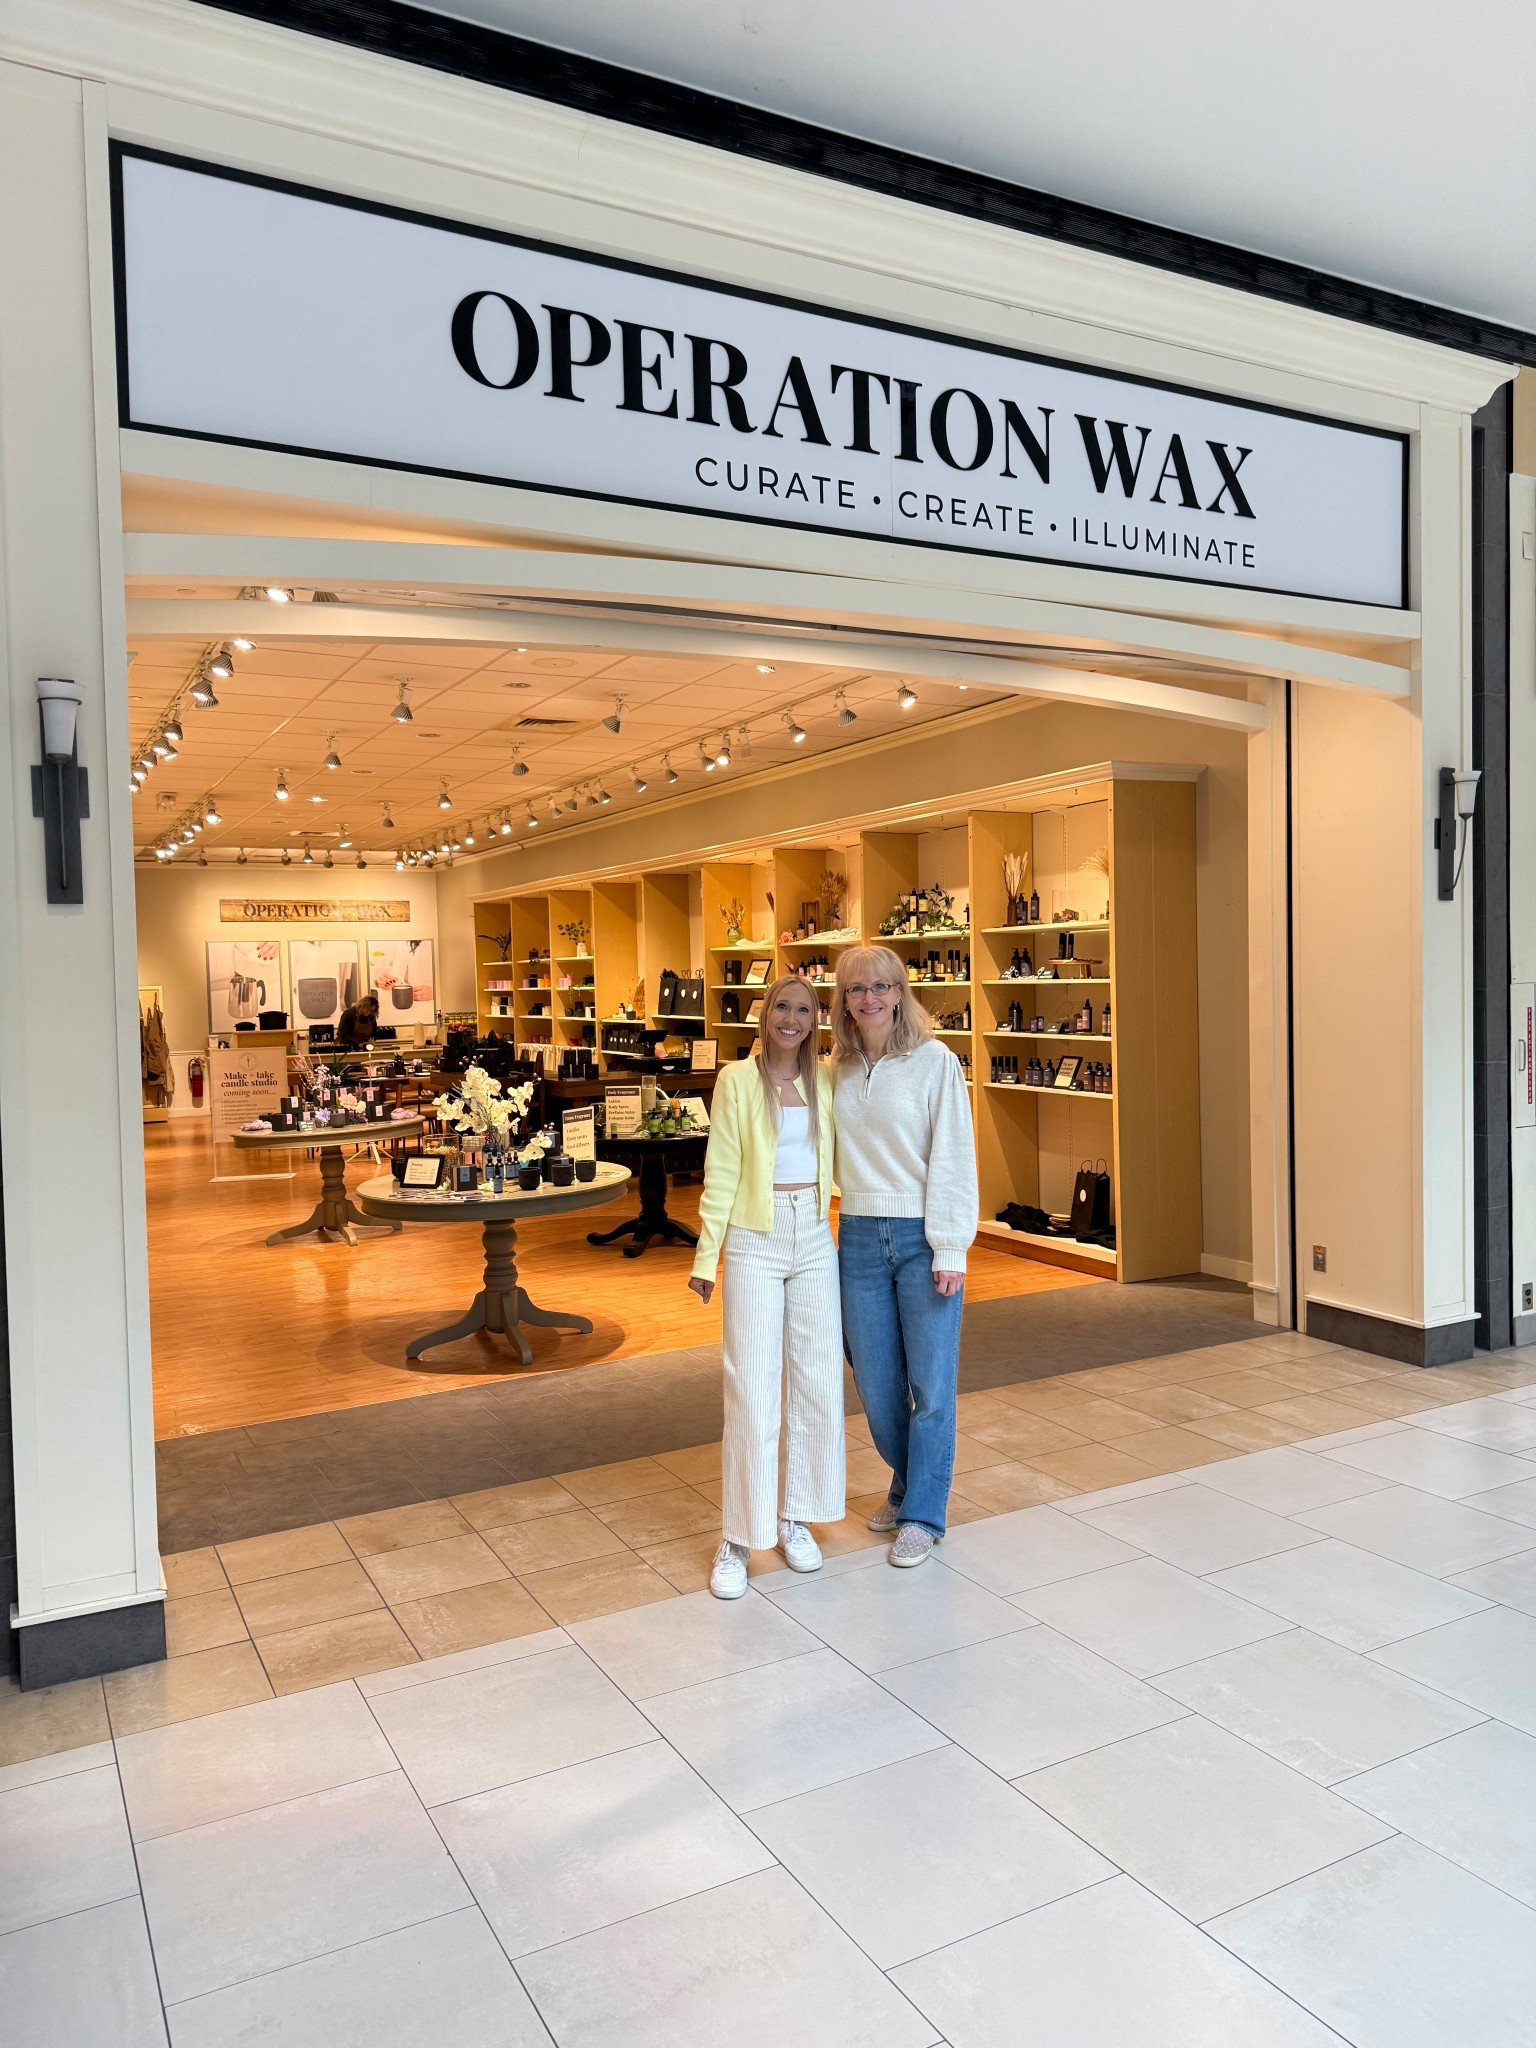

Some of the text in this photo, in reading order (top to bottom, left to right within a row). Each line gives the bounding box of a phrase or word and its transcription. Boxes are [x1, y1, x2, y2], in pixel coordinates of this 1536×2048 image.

[450, 290, 1257, 520] OPERATION WAX
[695, 457, 1257, 569] CURATE CREATE ILLUMINATE
[224, 1072, 248, 1080] Make
[256, 1071, 275, 1079] take
[221, 1078, 278, 1088] candle studio
[223, 1089, 251, 1098] coming
